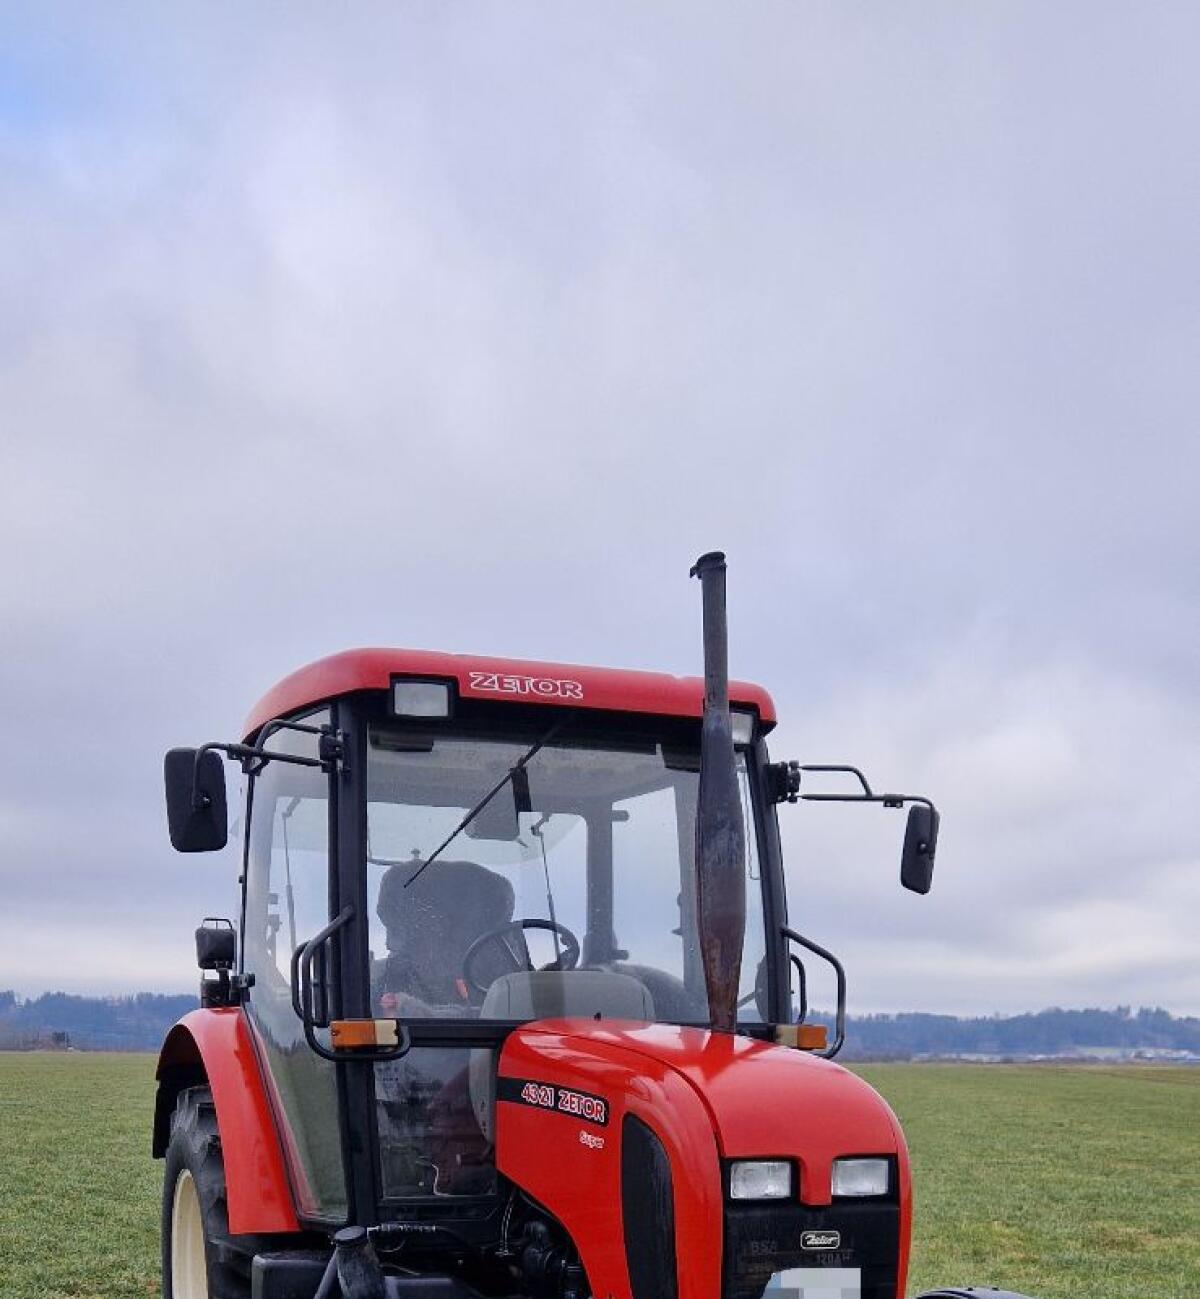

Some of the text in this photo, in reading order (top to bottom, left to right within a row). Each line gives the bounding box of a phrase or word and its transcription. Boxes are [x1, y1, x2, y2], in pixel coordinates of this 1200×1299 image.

[469, 672, 584, 699] ZETOR
[521, 1083, 605, 1123] 4321 ZETOR
[580, 1130, 604, 1149] Super
[805, 1234, 839, 1245] Zetor
